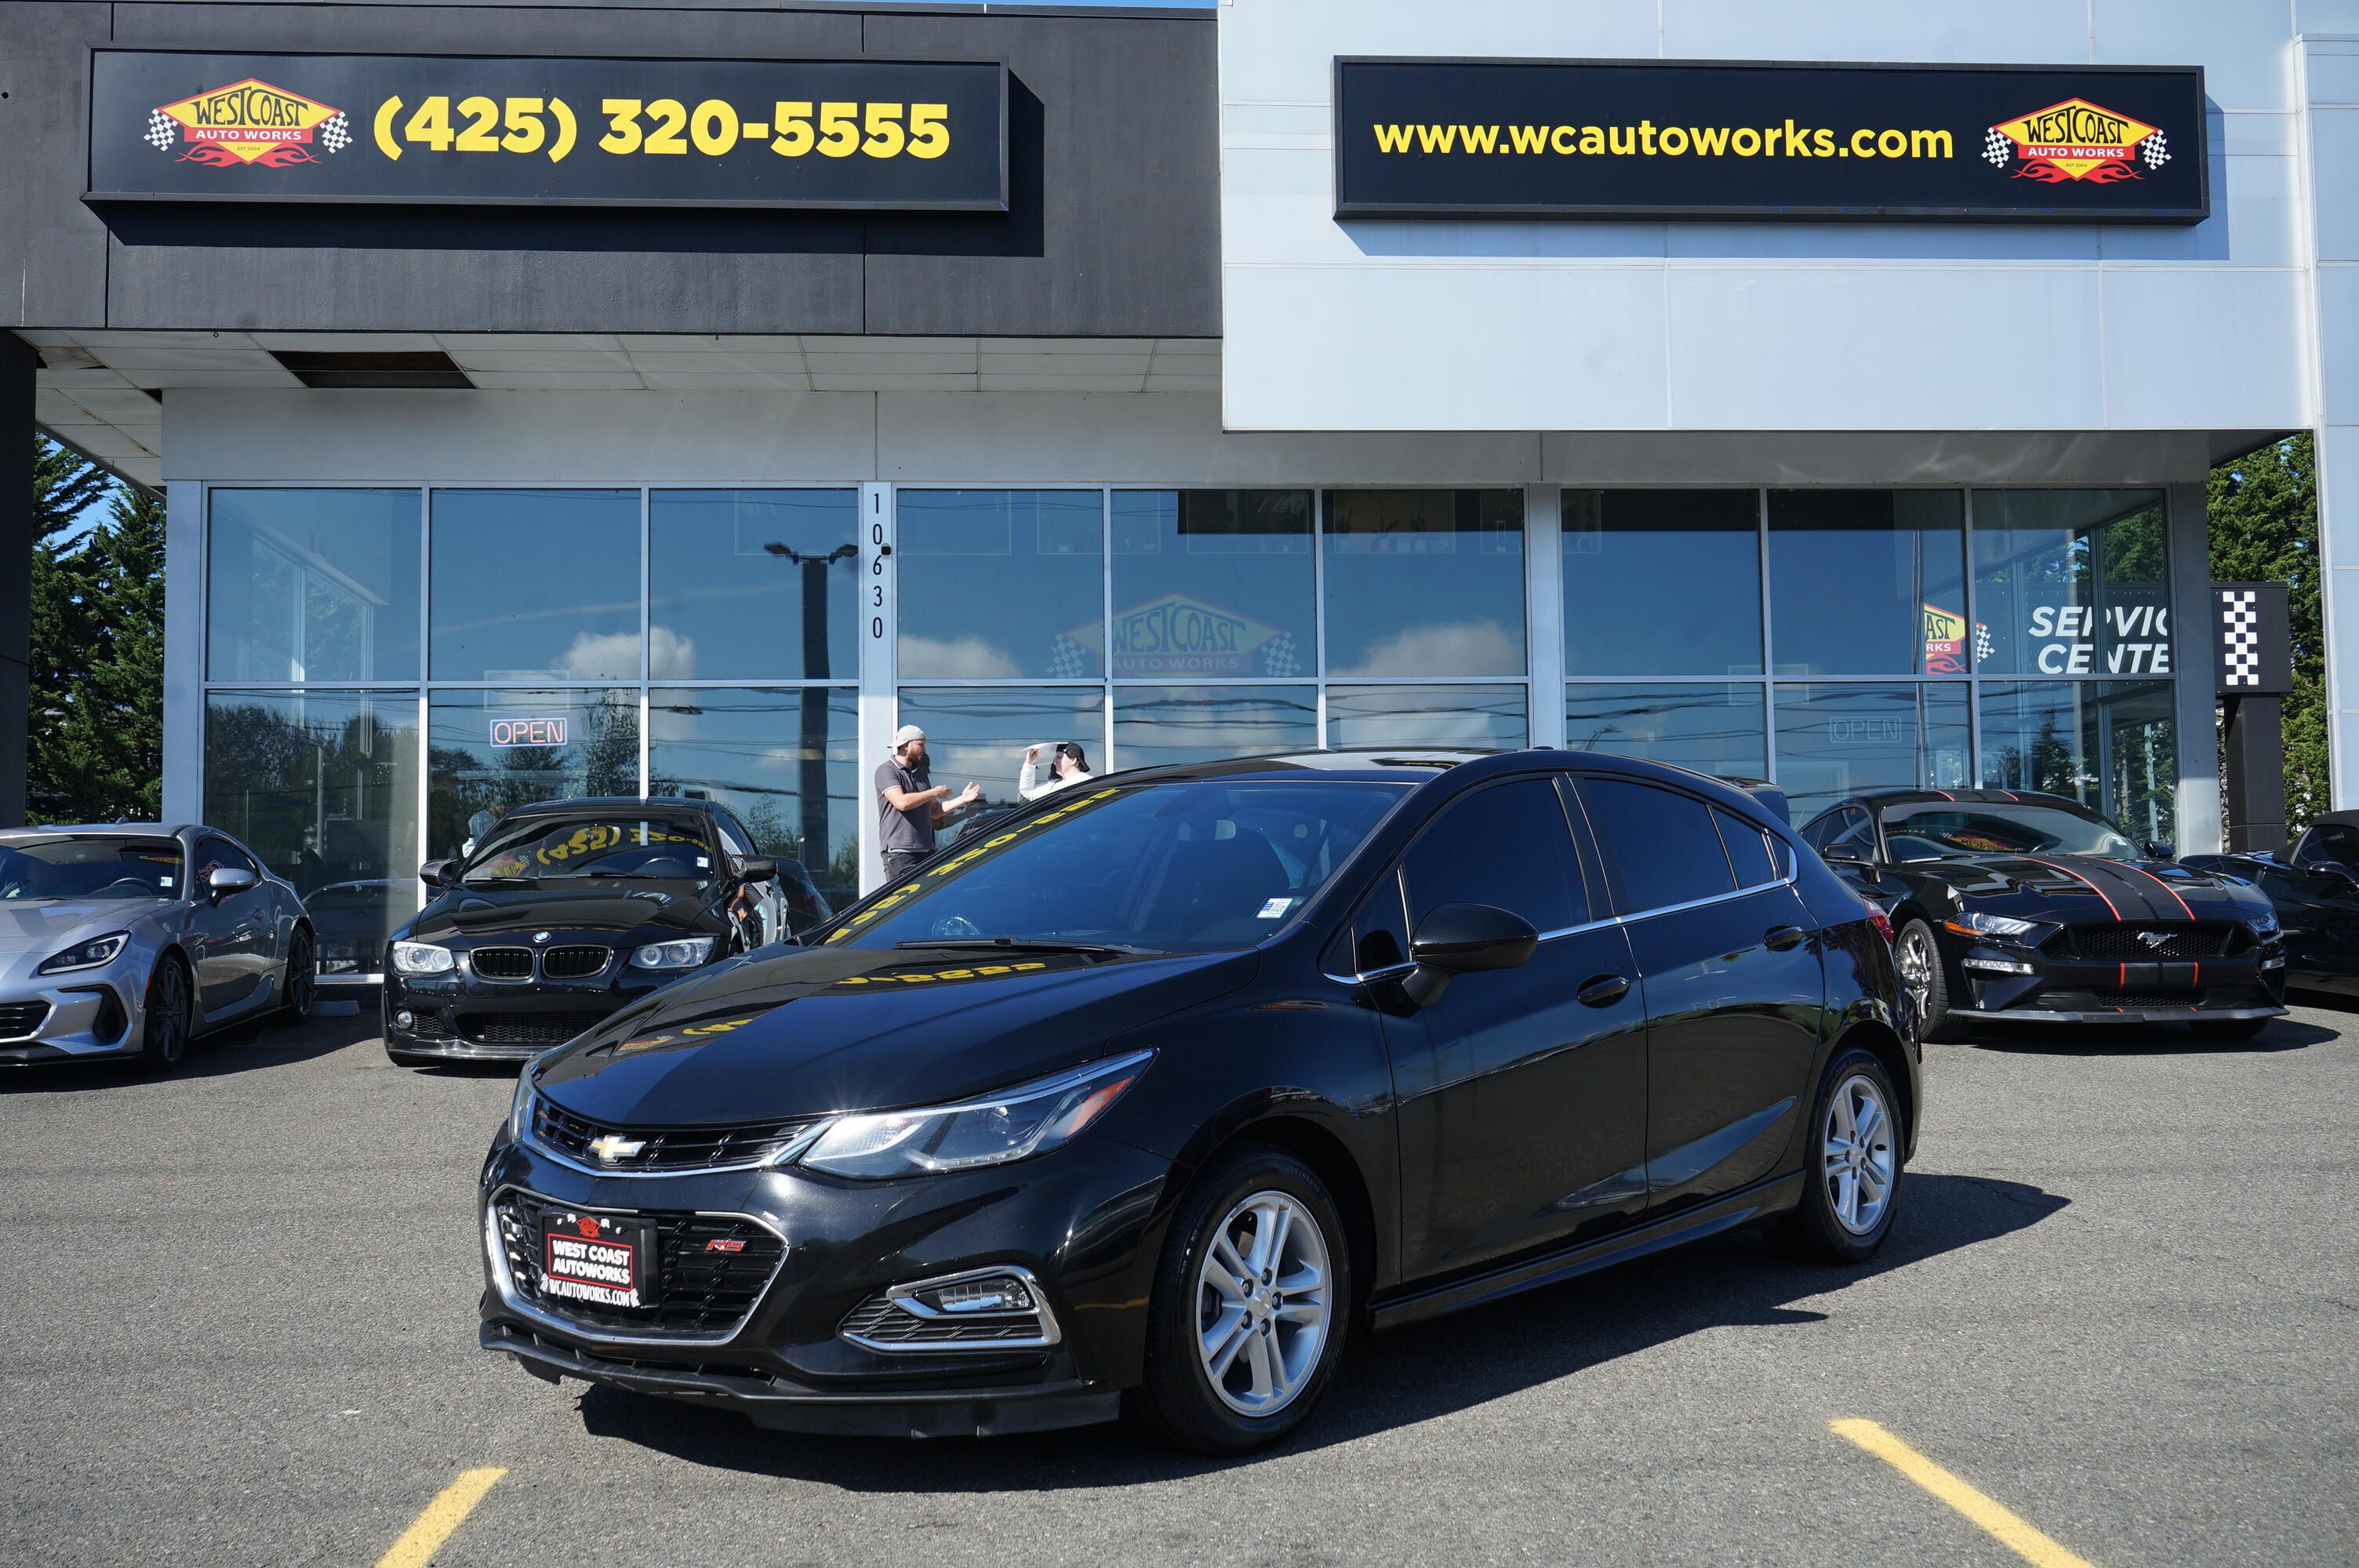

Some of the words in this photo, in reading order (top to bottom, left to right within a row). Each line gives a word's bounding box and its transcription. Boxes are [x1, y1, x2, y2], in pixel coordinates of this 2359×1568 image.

[196, 129, 240, 140] AUTO
[245, 130, 302, 140] WORKS
[373, 95, 577, 163] (425)
[598, 98, 951, 159] 320-5555
[1373, 119, 1953, 159] www.wcautoworks.com
[2028, 147, 2067, 157] AUTO
[2072, 147, 2125, 158] WORKS
[872, 492, 883, 639] 10630
[1113, 657, 1163, 670] AUTO
[1169, 656, 1239, 669] WORKS
[2038, 644, 2169, 674] CENTE
[494, 720, 563, 744] OPEN
[1834, 719, 1898, 741] OPEN
[552, 1240, 588, 1259] WEST
[588, 1245, 631, 1266] COAST
[706, 1239, 747, 1252] RS
[552, 1258, 631, 1285] AUTOWORKS
[549, 1278, 631, 1307] WCAUTOWORKS.COM
